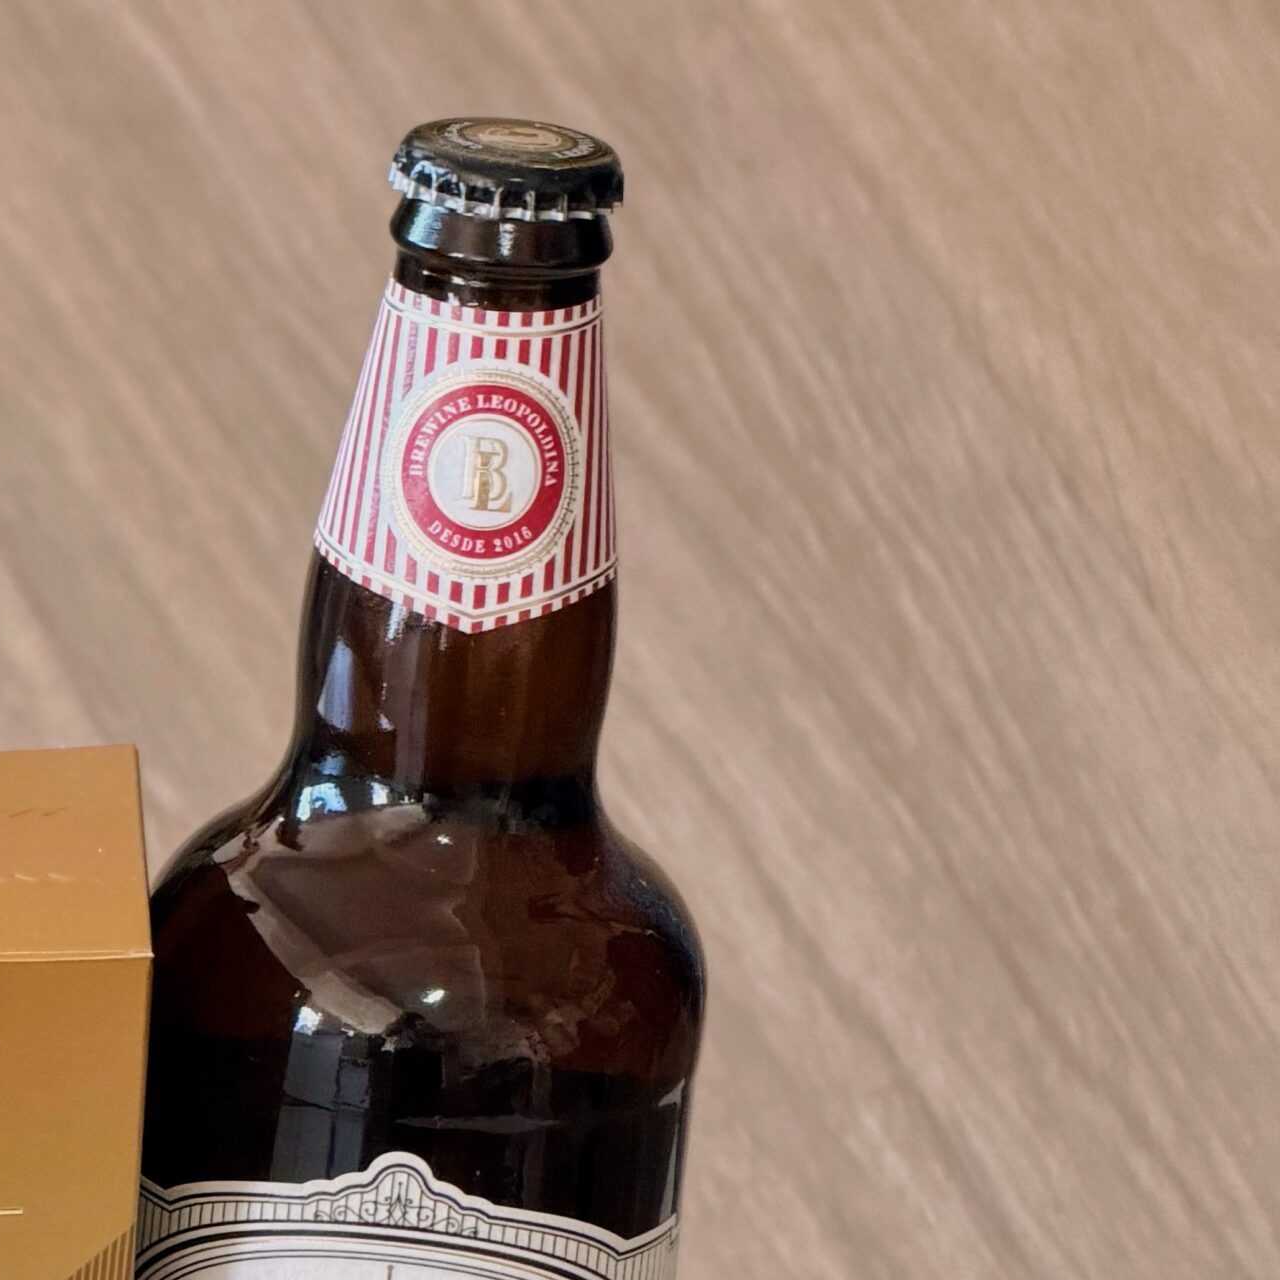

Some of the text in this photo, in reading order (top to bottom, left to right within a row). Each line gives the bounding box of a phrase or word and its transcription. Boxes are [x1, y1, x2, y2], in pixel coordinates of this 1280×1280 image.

[477, 393, 559, 488] LEOPOLDINA
[428, 520, 533, 554] DESDE 2016
